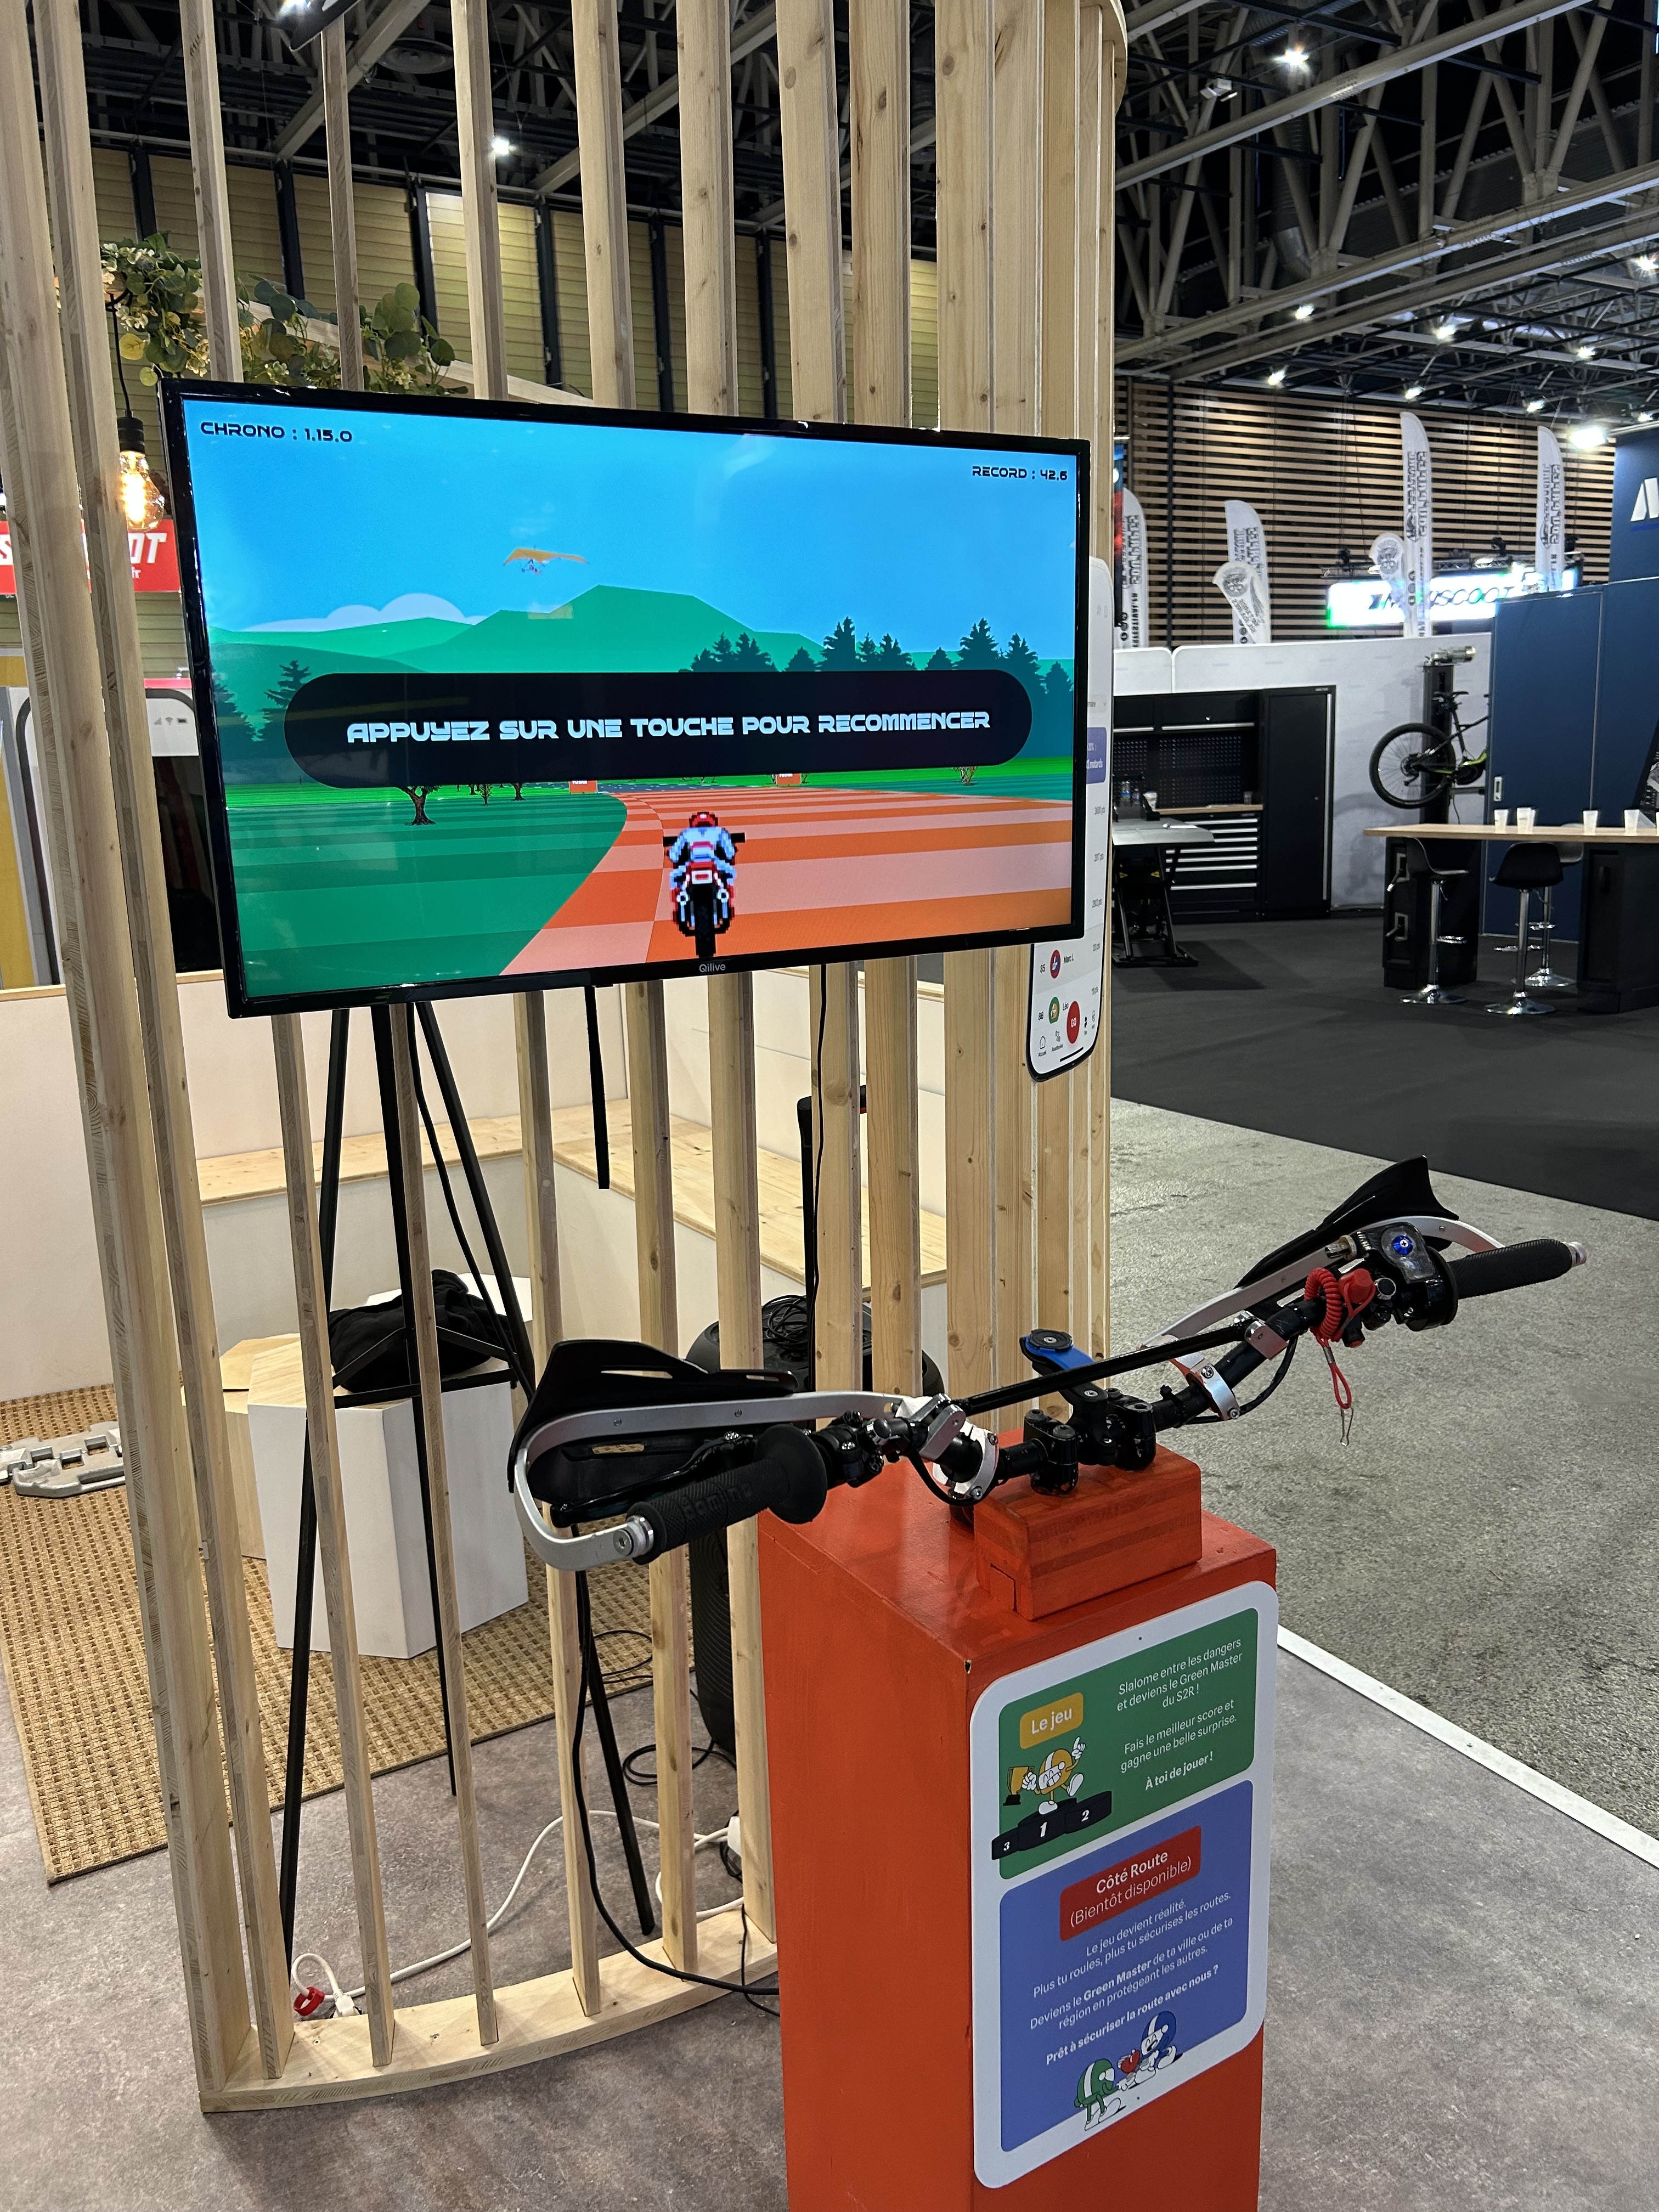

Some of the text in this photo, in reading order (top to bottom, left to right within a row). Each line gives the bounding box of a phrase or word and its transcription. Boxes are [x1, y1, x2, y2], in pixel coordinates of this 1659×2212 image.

[200, 421, 285, 438] CHRONO
[304, 428, 353, 443] 1.15.0
[972, 466, 1028, 478] RECORD
[1040, 469, 1068, 481] 42.6
[347, 712, 991, 743] APPUYEZ SUR UNE TOUCHE POUR RECOMMENCER
[699, 963, 726, 973] Qilive
[1117, 1652, 1243, 1711] et deviens le Green Master
[1119, 1639, 1242, 1695] Slalome entre les dangers
[1163, 1695, 1175, 1708] du
[1176, 1686, 1194, 1702] S2R
[1032, 1708, 1072, 1734] Le jeu
[1125, 1699, 1234, 1754] Fais le meilleur score et
[1121, 1715, 1238, 1774] gagne une belle surprise.
[1146, 1776, 1153, 1791] À
[1154, 1771, 1168, 1786] toi
[1169, 1767, 1182, 1779] de
[1183, 1754, 1209, 1776] jouer
[1040, 1822, 1047, 1837] 1
[1081, 1810, 1089, 1822] 2
[1003, 1841, 1010, 1851] 3
[1070, 1855, 1191, 1928] (Bientôt disponible)
[1096, 1852, 1168, 1893] Côté Route
[1034, 1892, 1231, 1998] Plus tu roules, plus tu sécurises les routes.
[1086, 1898, 1186, 1956] Le jeu devient réalité.
[1030, 1917, 1233, 2030] Deviens le Green Master de ta ville ou de ta
[1059, 1945, 1208, 2029] région en protégeant les autres.
[1046, 1964, 1219, 2066] Prêt à sécuriser la route avec nous ?
